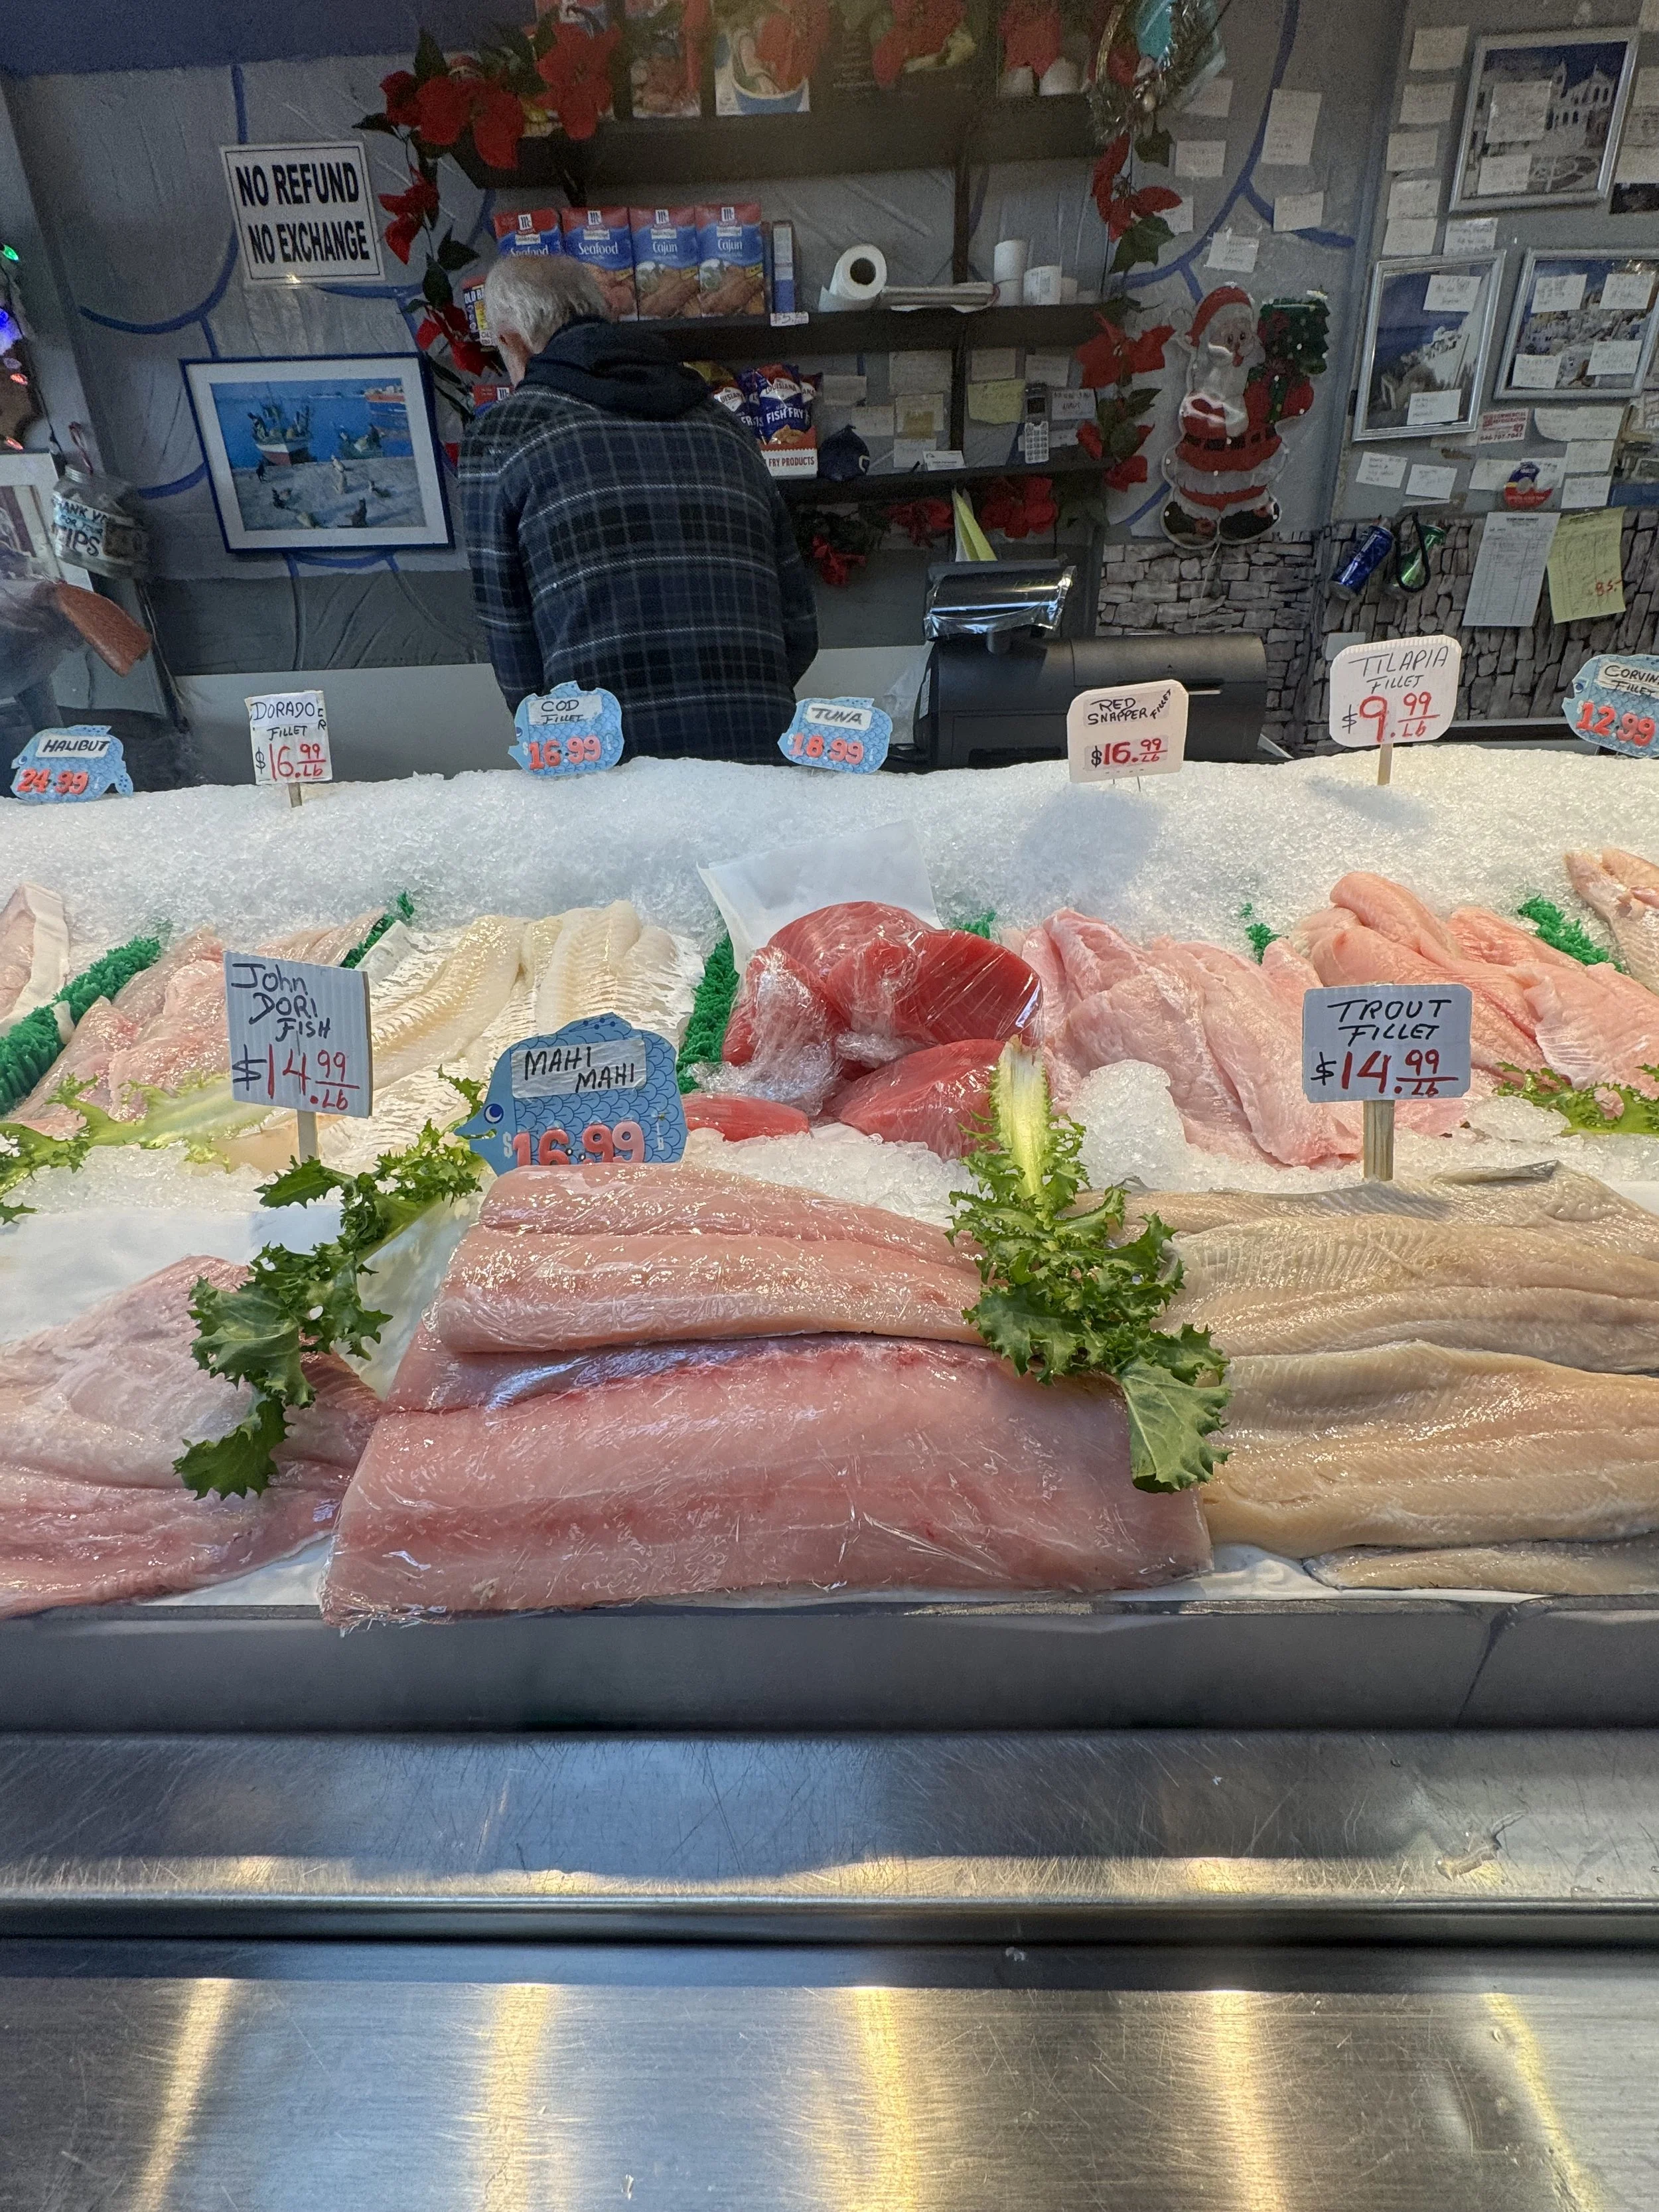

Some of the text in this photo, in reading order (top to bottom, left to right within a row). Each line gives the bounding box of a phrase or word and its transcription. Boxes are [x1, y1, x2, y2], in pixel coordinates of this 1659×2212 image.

[236, 162, 359, 206] NO REFUND
[248, 220, 370, 264] NO EXCHANGE
[578, 242, 618, 256] Seafood
[652, 241, 678, 256] Cajun
[717, 238, 743, 253] Cajun
[477, 289, 484, 301] B
[766, 409, 787, 423] FISH
[788, 407, 803, 419] FRY
[768, 456, 815, 467] FRY PRODUCTS
[1348, 646, 1449, 677] TILAPIA
[1605, 665, 1659, 685] CORVIN
[1366, 675, 1424, 694] FILLET
[1611, 680, 1656, 698] FILLET
[251, 701, 315, 721] DORADO
[541, 699, 579, 712] COD
[1090, 698, 1136, 712] RED
[1150, 689, 1171, 719] FILLET
[541, 714, 583, 724] FILLET
[811, 707, 862, 725] TUNA
[1088, 707, 1148, 725] SNAPPER
[267, 725, 307, 741] FILLET
[42, 739, 111, 753] HALIBUT
[249, 992, 318, 1025] DORI
[1327, 999, 1452, 1023] TROUT
[275, 1017, 331, 1042] FISH
[1338, 1023, 1440, 1047] FILLET
[524, 1046, 592, 1080] MAHI
[575, 1063, 635, 1093] MAHI
